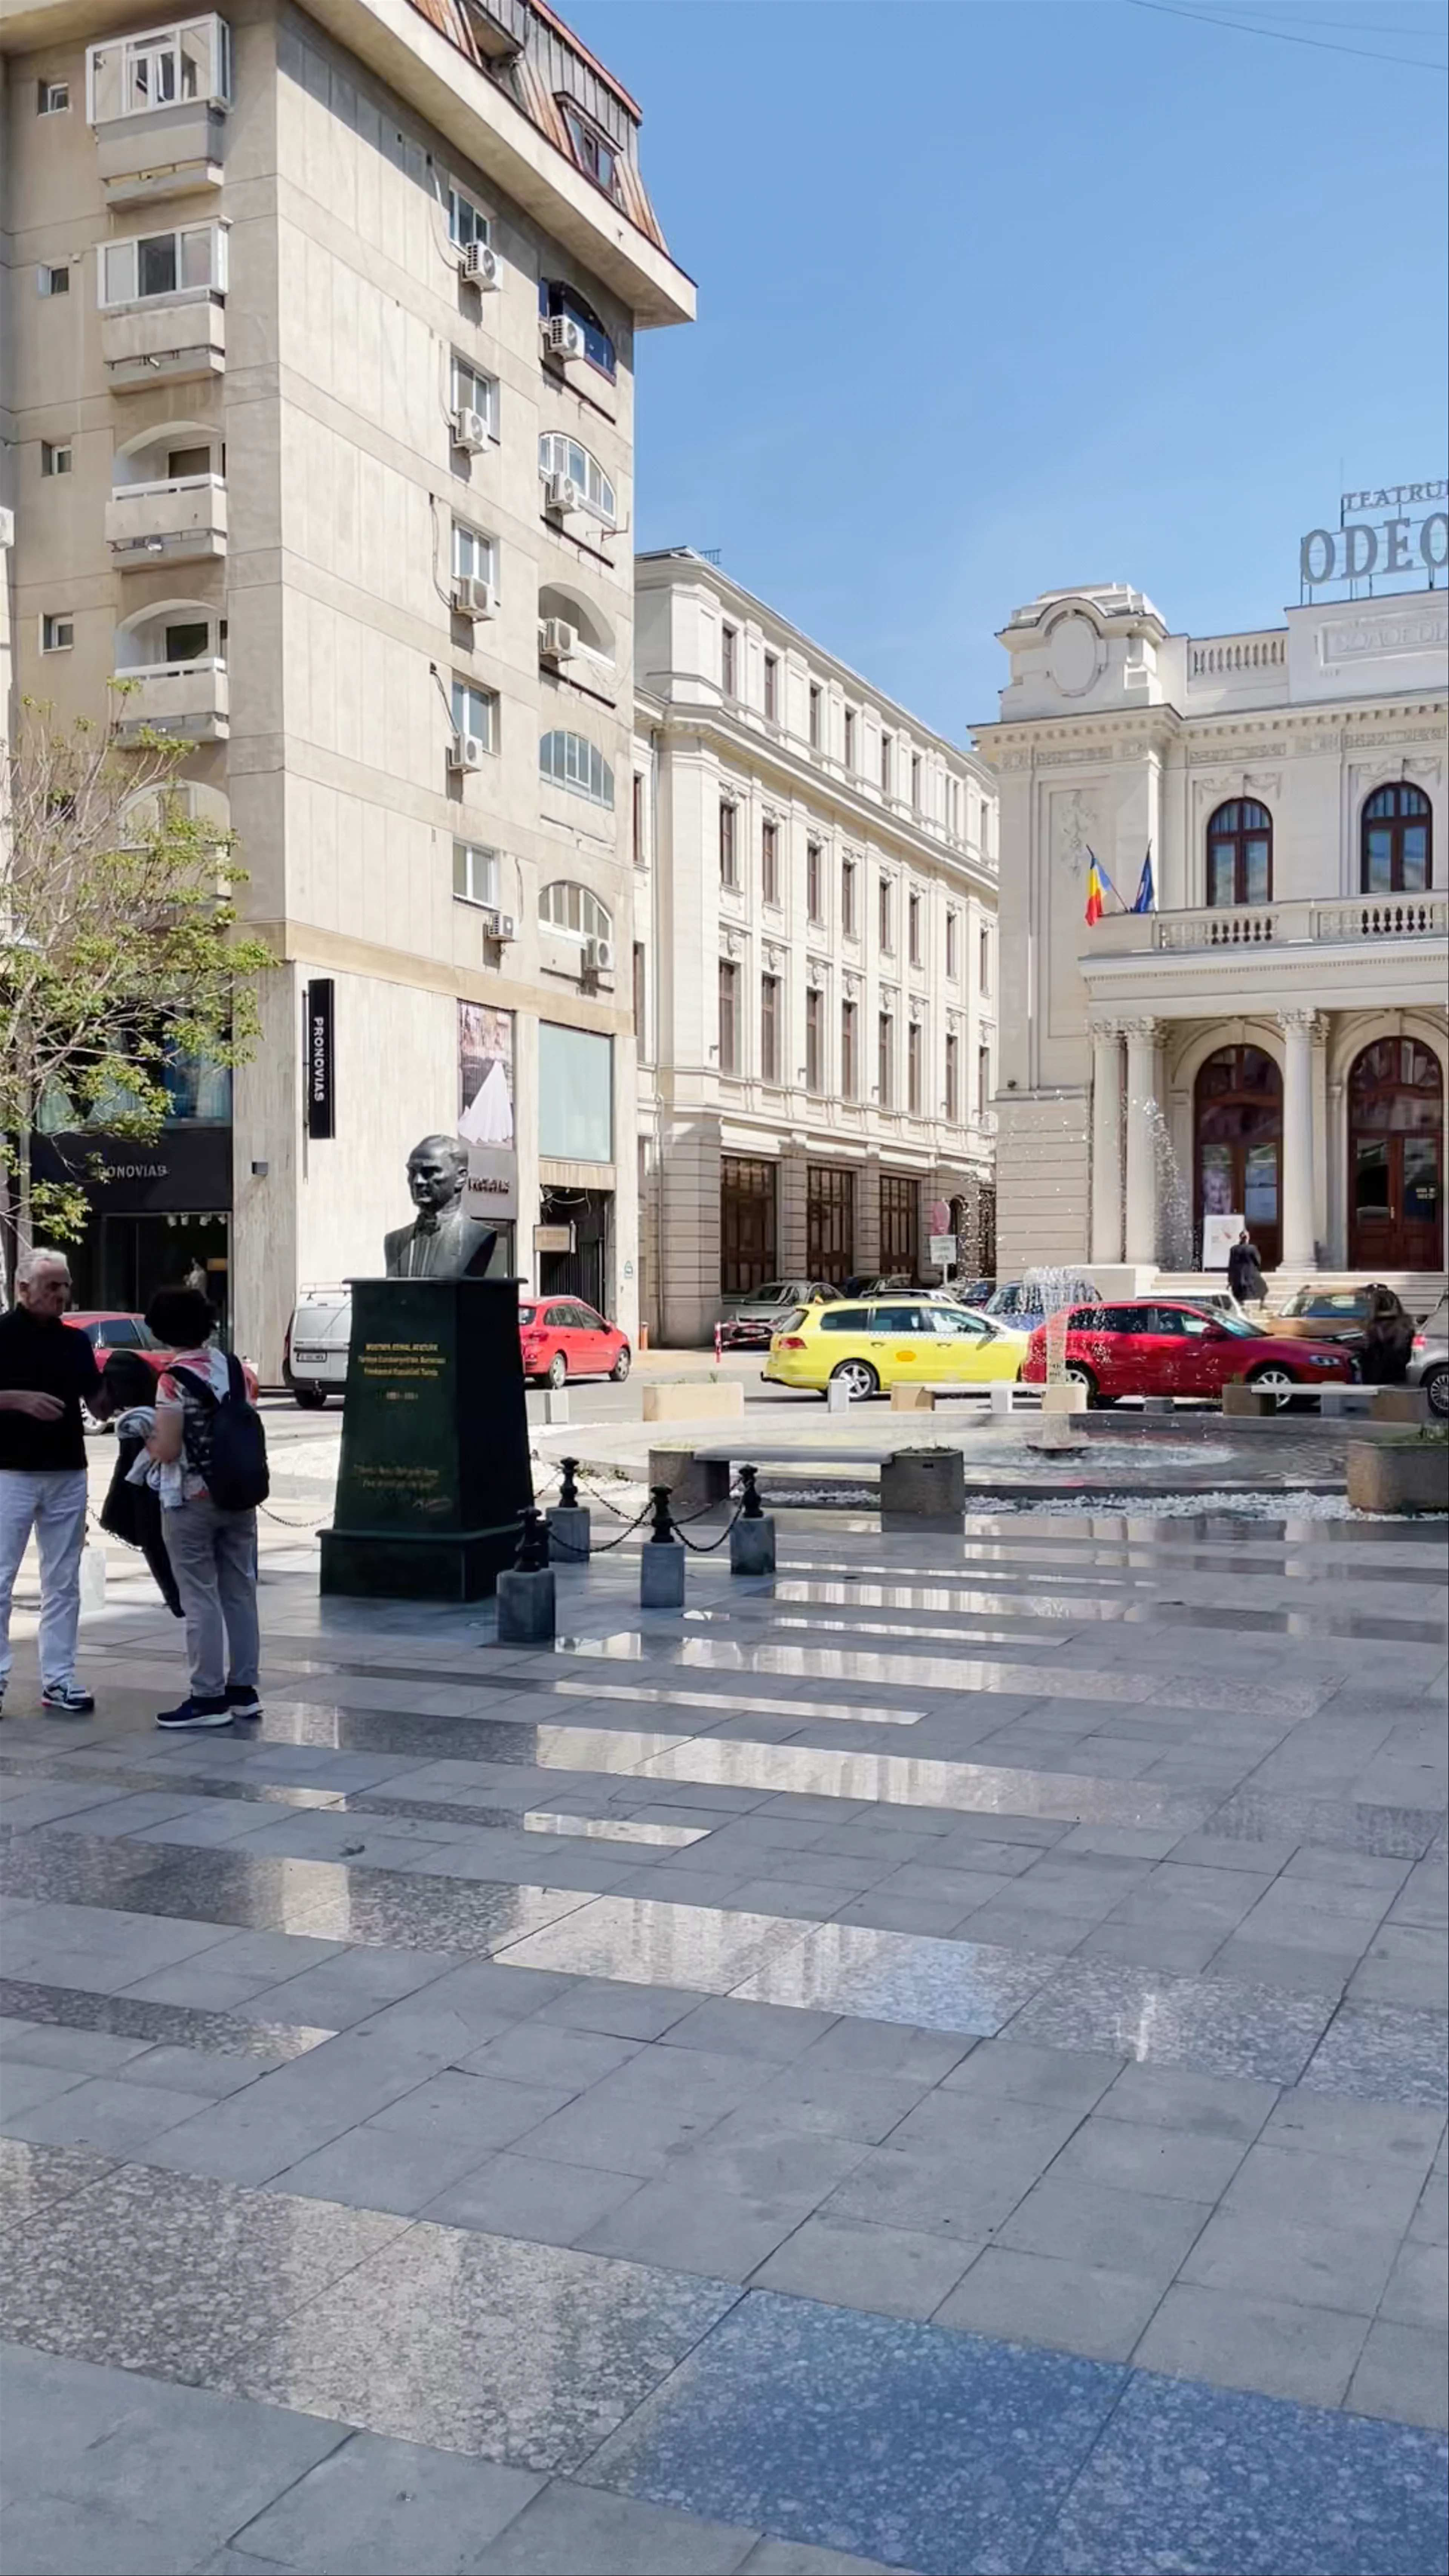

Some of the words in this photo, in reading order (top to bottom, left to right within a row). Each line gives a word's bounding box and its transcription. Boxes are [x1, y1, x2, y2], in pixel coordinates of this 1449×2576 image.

[1342, 479, 1448, 509] TEATRU
[1300, 512, 1448, 584] ODEO
[314, 1016, 324, 1101] PRONOVIAS
